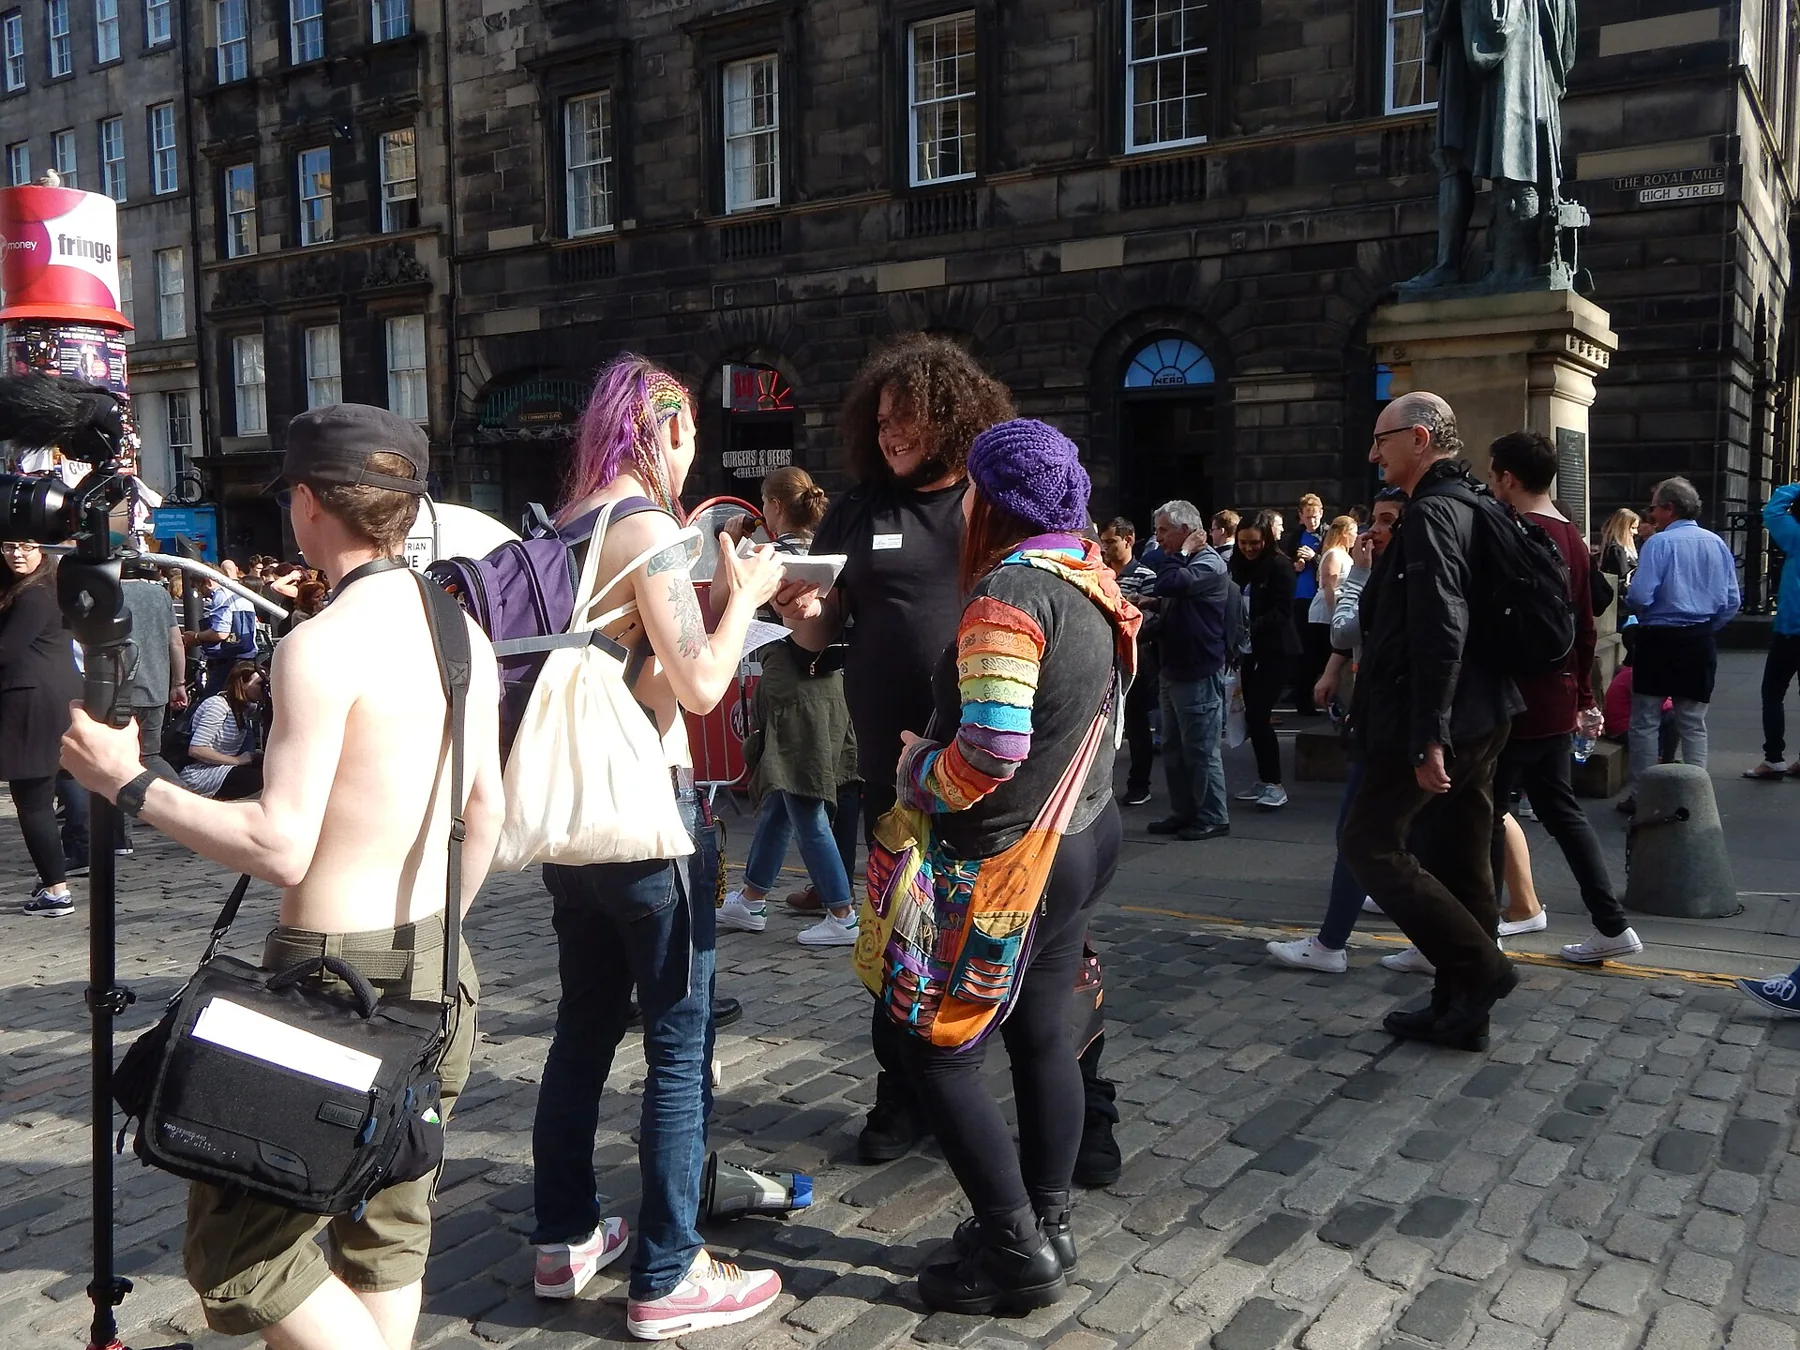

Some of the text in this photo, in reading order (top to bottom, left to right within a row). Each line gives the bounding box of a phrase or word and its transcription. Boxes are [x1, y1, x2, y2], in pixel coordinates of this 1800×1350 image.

[1617, 168, 1723, 189] THE ROYAL MILE
[1642, 184, 1723, 201] HIGH STREET
[8, 240, 37, 251] money
[58, 233, 111, 264] fringe
[722, 449, 793, 468] BURGERS & BEERS
